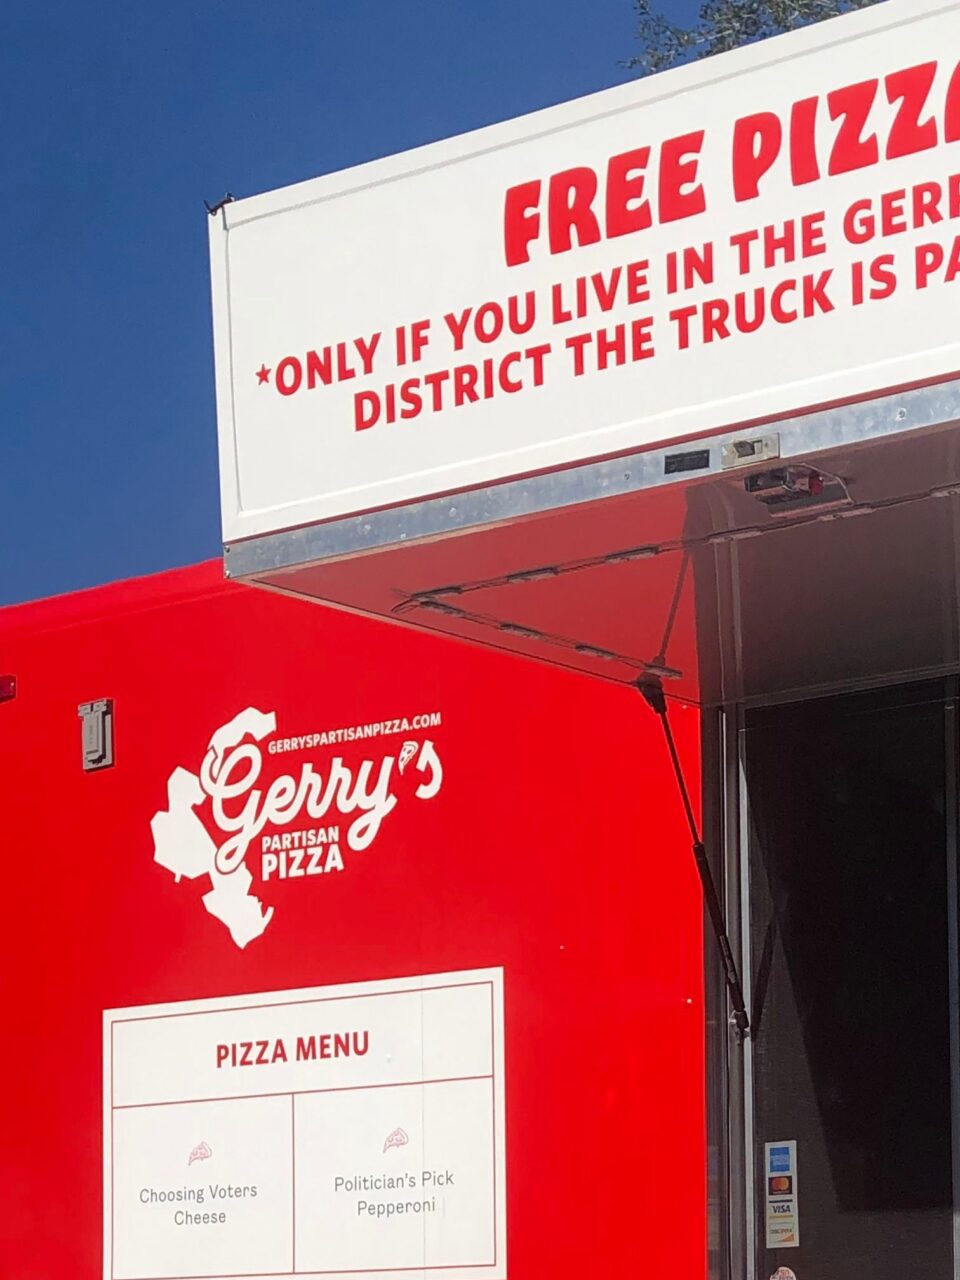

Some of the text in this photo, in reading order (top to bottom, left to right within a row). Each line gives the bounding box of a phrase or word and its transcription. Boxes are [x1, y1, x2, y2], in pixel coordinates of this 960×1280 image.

[503, 129, 707, 268] FREE
[395, 319, 431, 366] IF
[443, 291, 537, 351] YOU
[551, 259, 651, 325] LIVE
[666, 242, 714, 295] IN
[729, 211, 827, 276] THE
[354, 343, 552, 432] DISTRICT
[565, 316, 656, 377] THE
[669, 269, 834, 350] TRUCK
[851, 254, 898, 306] IS
[268, 712, 442, 755] GERRYSPARTISANPIZZA.COM
[200, 739, 443, 875] Gerry's
[261, 825, 340, 853] PARTISAN
[261, 843, 345, 882] PIZZA
[216, 1030, 370, 1068] PIZZA MENU
[139, 1184, 258, 1205] Choosing Voters
[334, 1170, 455, 1193] Politician's Pick
[173, 1210, 227, 1226] Cheese
[357, 1199, 436, 1219] Pepperoni
[772, 1204, 791, 1214] VISA
